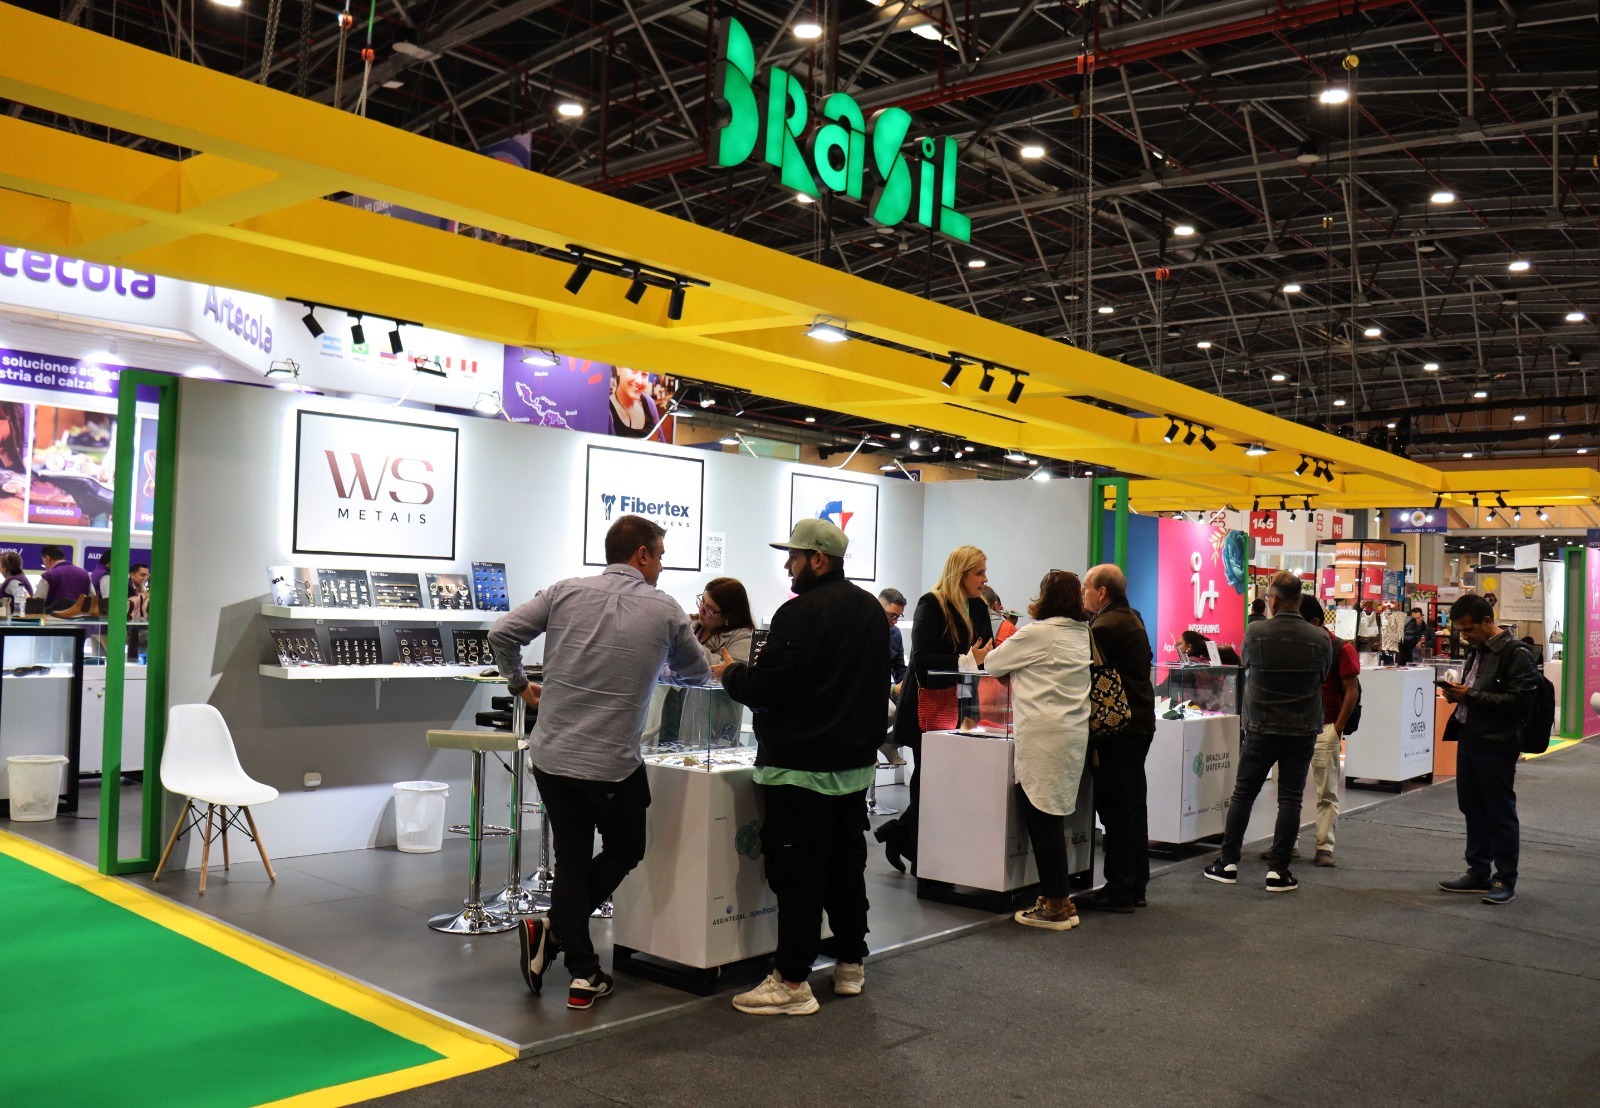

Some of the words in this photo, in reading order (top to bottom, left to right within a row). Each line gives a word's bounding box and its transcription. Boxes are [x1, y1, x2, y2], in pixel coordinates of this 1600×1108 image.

[203, 285, 273, 353] Artecola
[2, 356, 77, 375] soluciones
[34, 372, 56, 385] del
[323, 449, 435, 504] WS
[36, 506, 74, 516] Ensuelado
[620, 495, 690, 518] Fibertex
[338, 507, 427, 525] METAIS
[1410, 721, 1426, 733] ORIGEN
[1205, 752, 1230, 762] BRAZILIAN
[1205, 761, 1231, 771] MATERIALS
